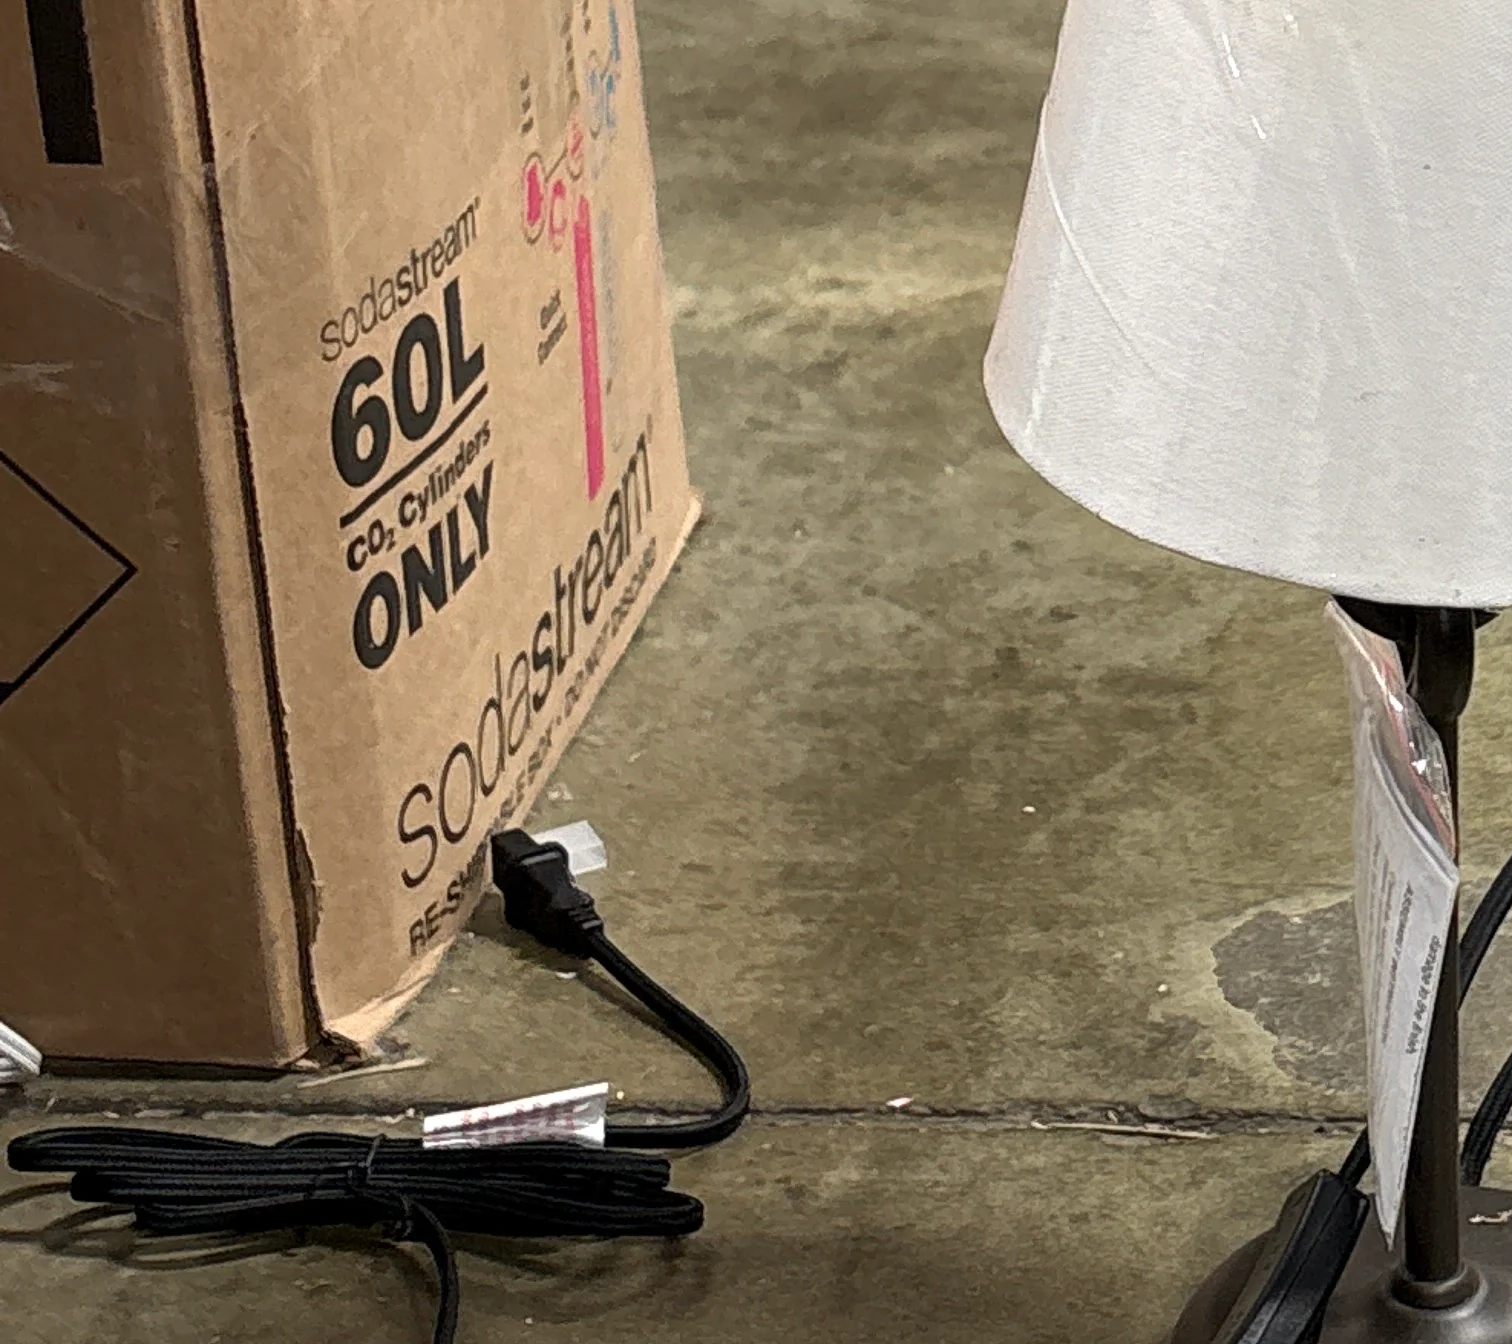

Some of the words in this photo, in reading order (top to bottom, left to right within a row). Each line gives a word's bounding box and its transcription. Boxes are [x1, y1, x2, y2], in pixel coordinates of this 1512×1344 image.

[320, 202, 478, 362] sodastream
[331, 275, 486, 488] 60L
[353, 459, 494, 670] ONLY
[398, 420, 491, 528] Cylinders
[397, 431, 653, 889] sodastream
